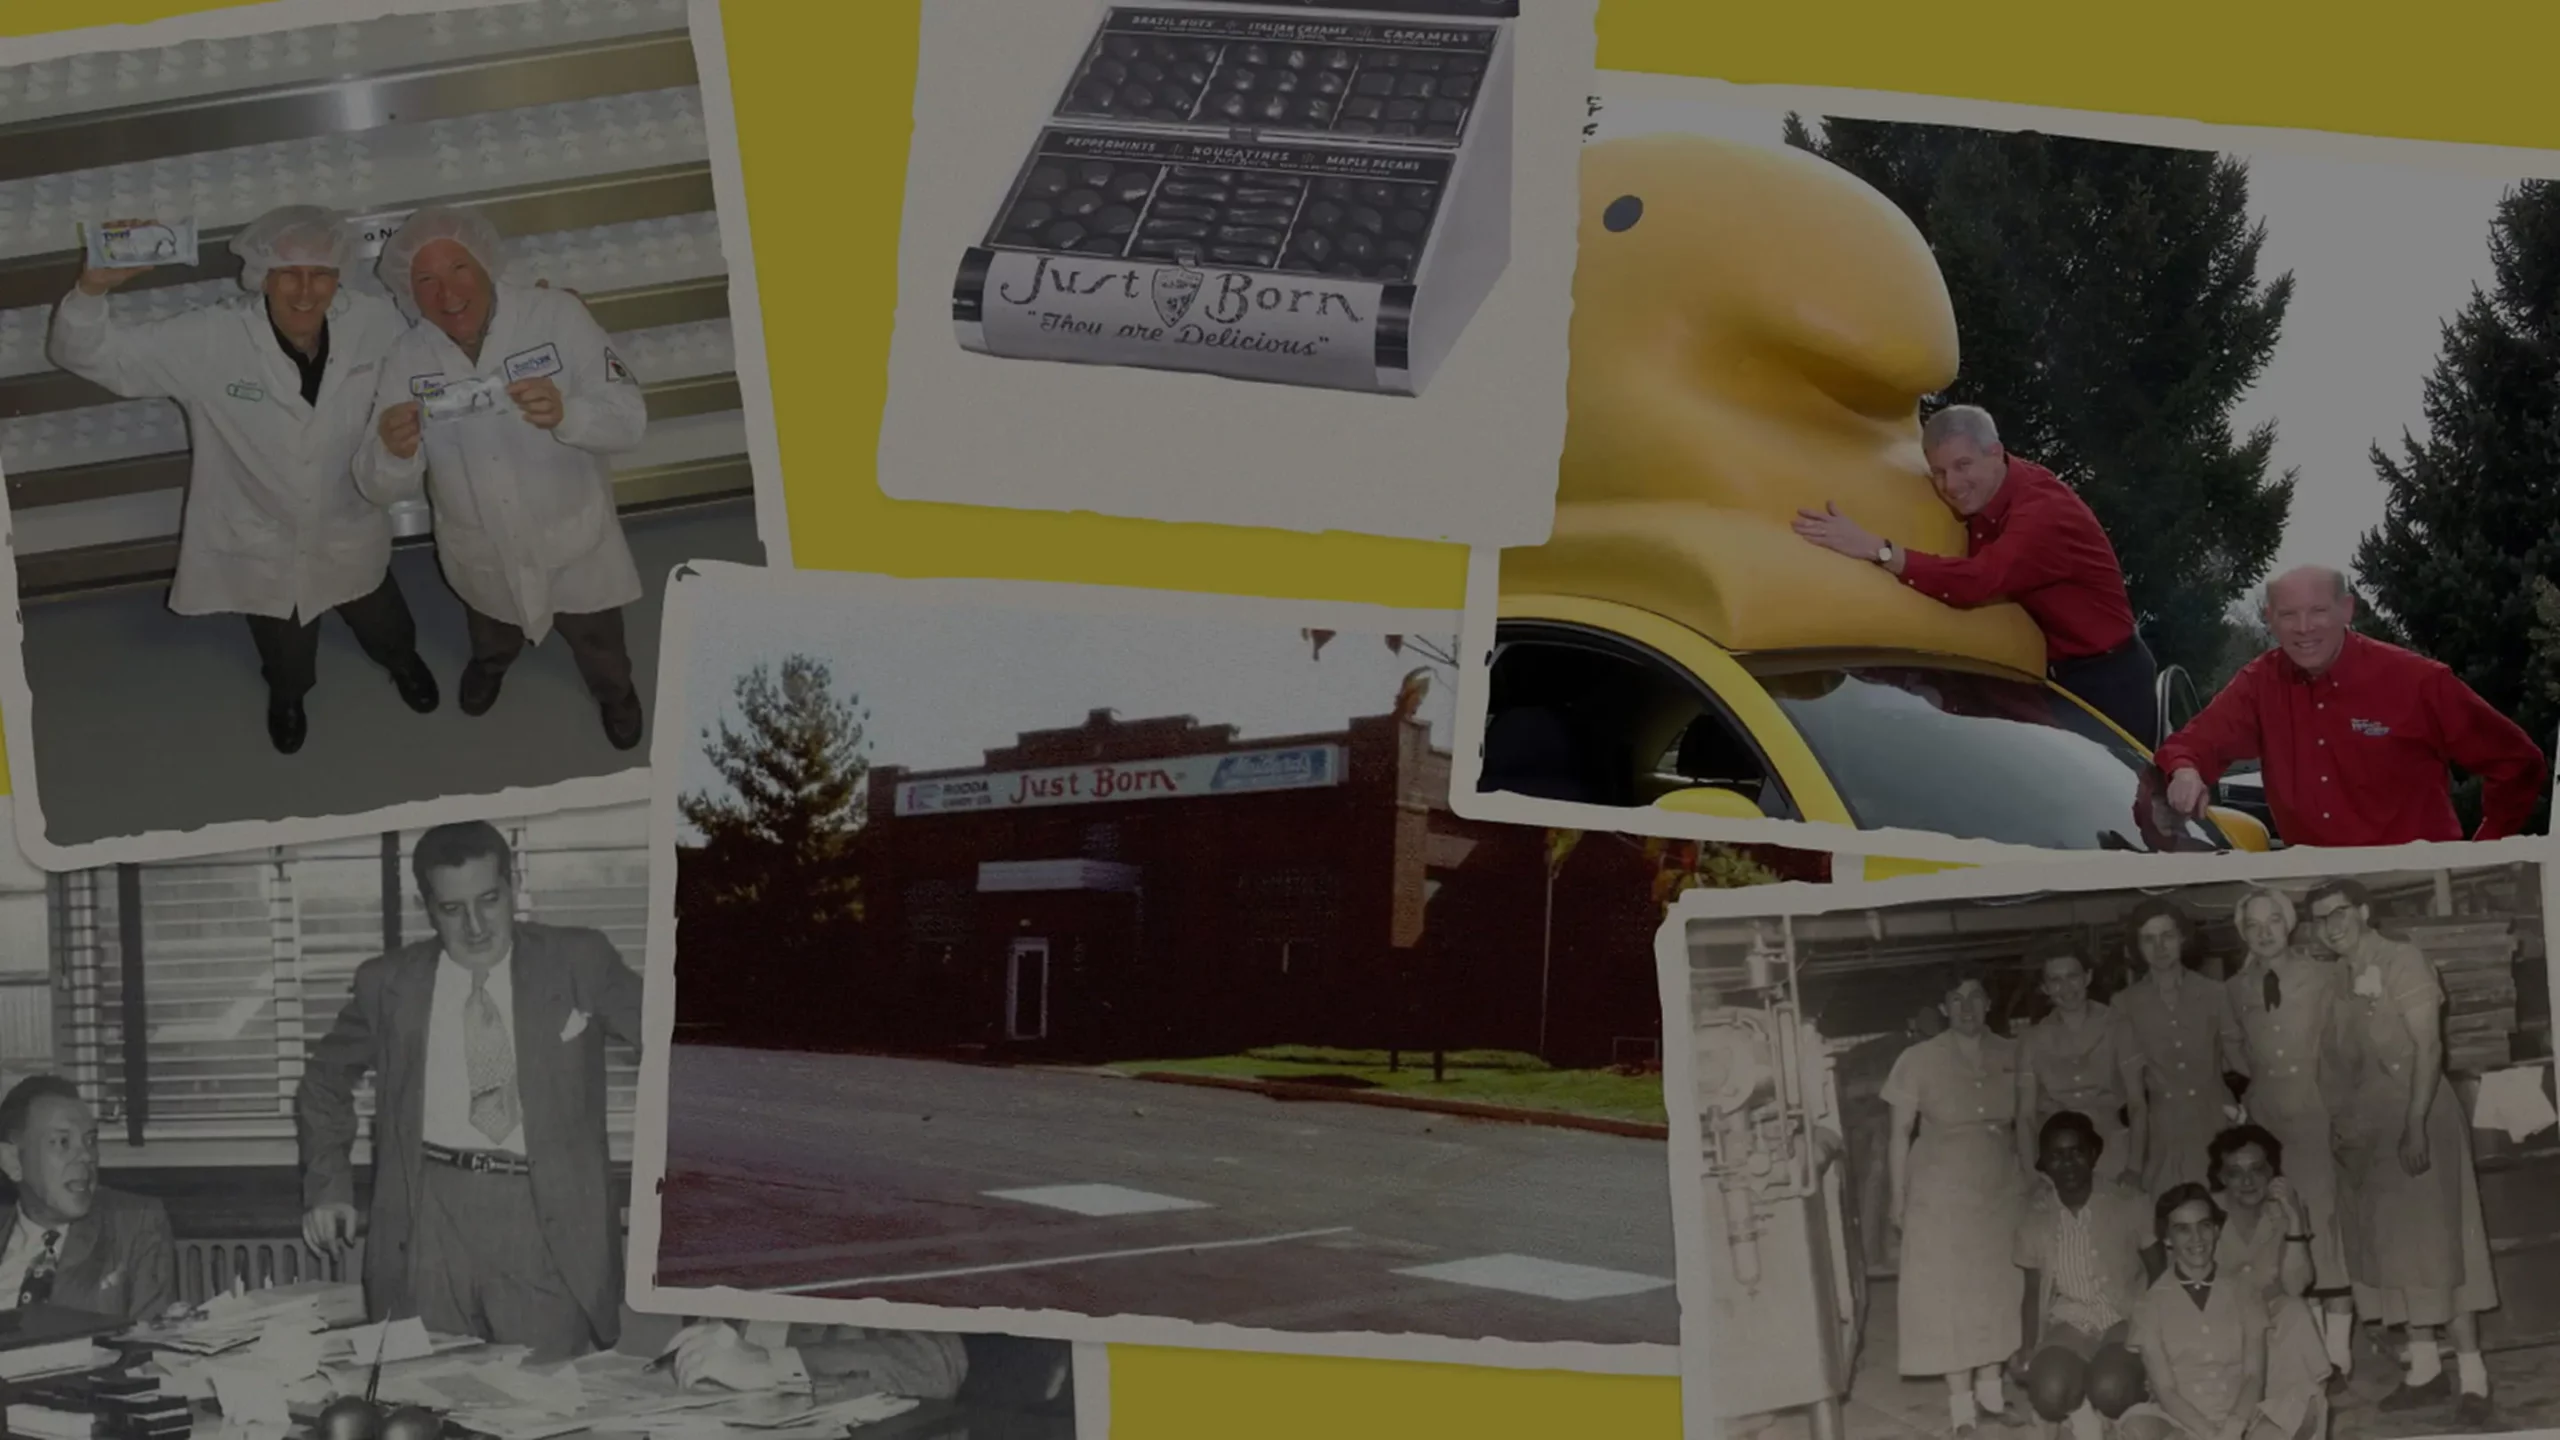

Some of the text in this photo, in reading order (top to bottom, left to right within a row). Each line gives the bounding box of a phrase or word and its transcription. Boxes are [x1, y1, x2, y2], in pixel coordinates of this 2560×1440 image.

[1132, 15, 1215, 28] BRAZIL NUTS
[1247, 22, 1295, 32] ITALIAN
[1297, 25, 1348, 35] CREAMS
[1383, 29, 1469, 43] CARAMELS
[1065, 136, 1157, 152] PEPPERMINTS
[1191, 146, 1290, 161] NOUGATINES
[1326, 155, 1369, 167] MAPLE
[1372, 159, 1420, 171] PECANS
[1000, 256, 1364, 324] Just Born
[1116, 323, 1164, 341] are
[1174, 323, 1329, 356] Delicious"
[1009, 766, 1178, 804] Just Born
